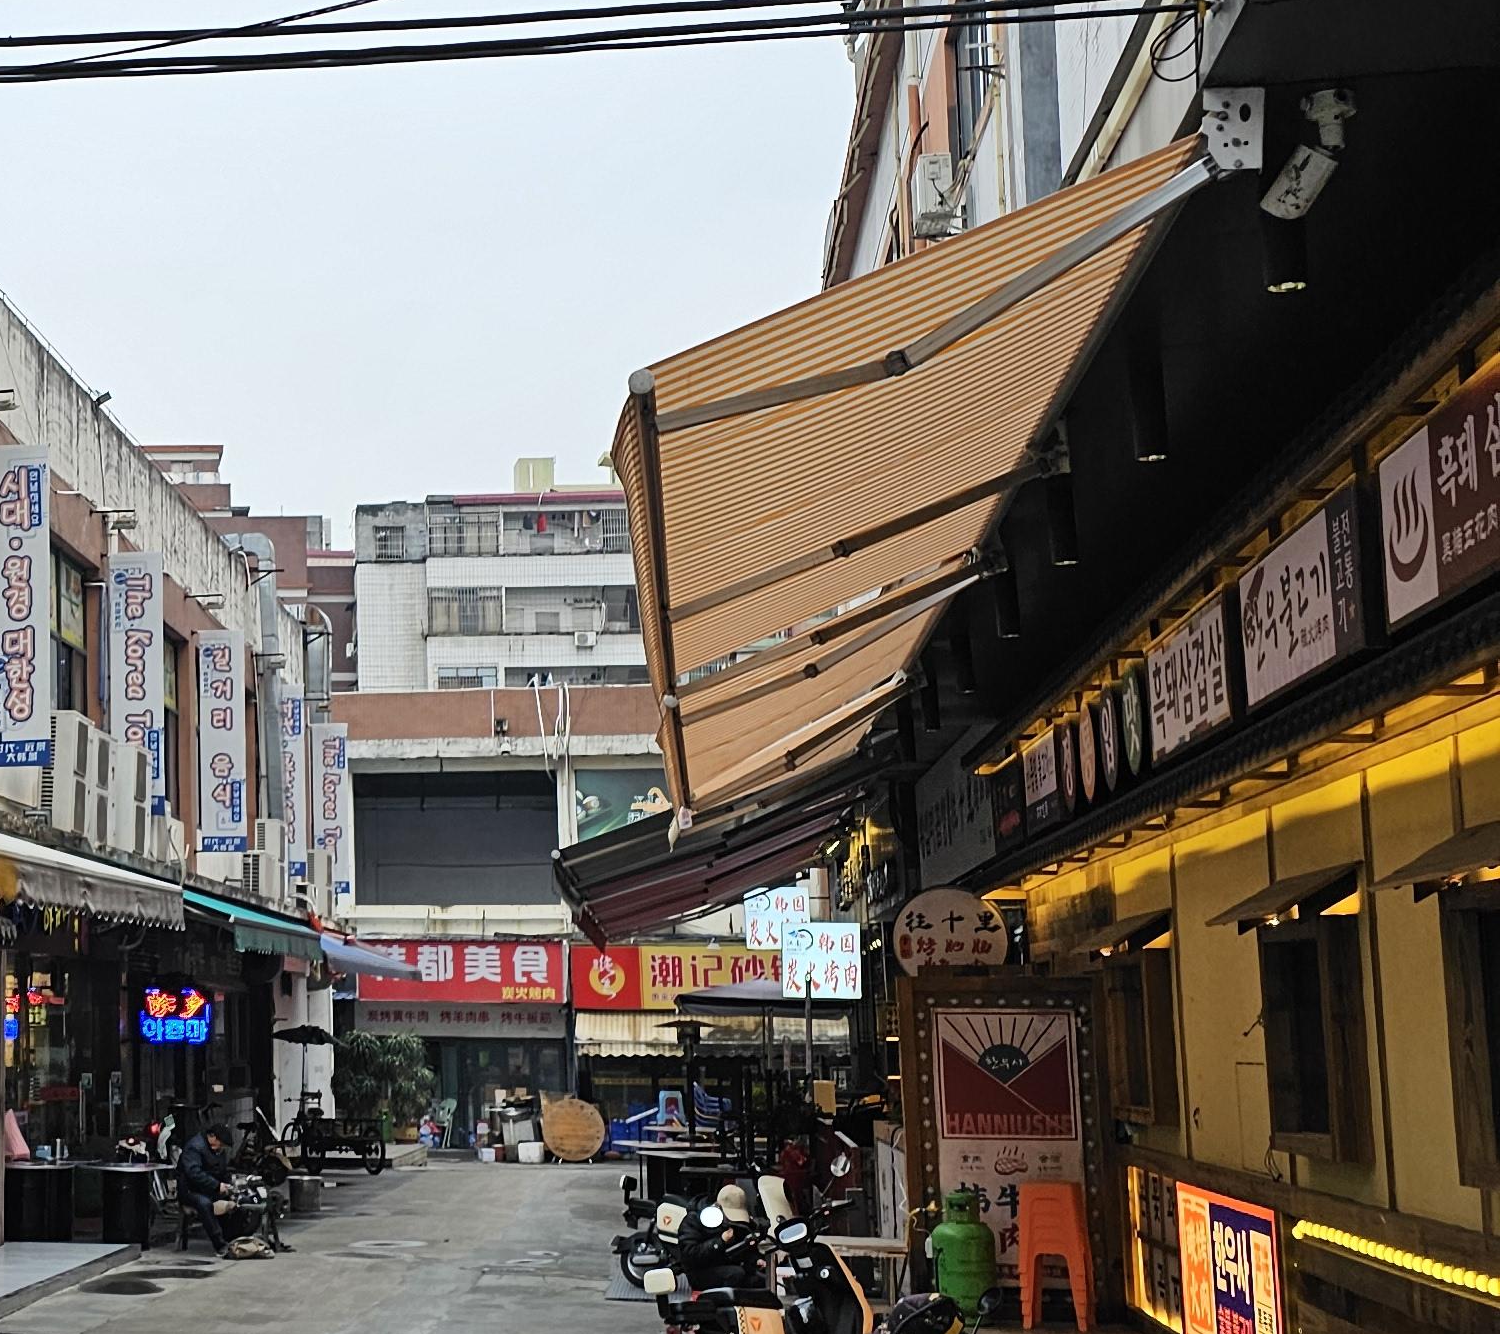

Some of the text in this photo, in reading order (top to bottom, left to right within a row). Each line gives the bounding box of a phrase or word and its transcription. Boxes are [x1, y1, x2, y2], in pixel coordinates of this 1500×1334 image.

[2, 555, 33, 622] 원경
[1, 624, 36, 722] 대한성
[124, 572, 153, 748] The Korea To
[322, 737, 341, 767] The
[322, 772, 342, 821] Korea
[819, 931, 855, 954] 韩国
[905, 910, 1002, 934] 往十里
[786, 958, 858, 994] 炭火烤肉
[946, 1112, 1072, 1136] HANNIUSHE
[1213, 1220, 1251, 1305] 한우사
